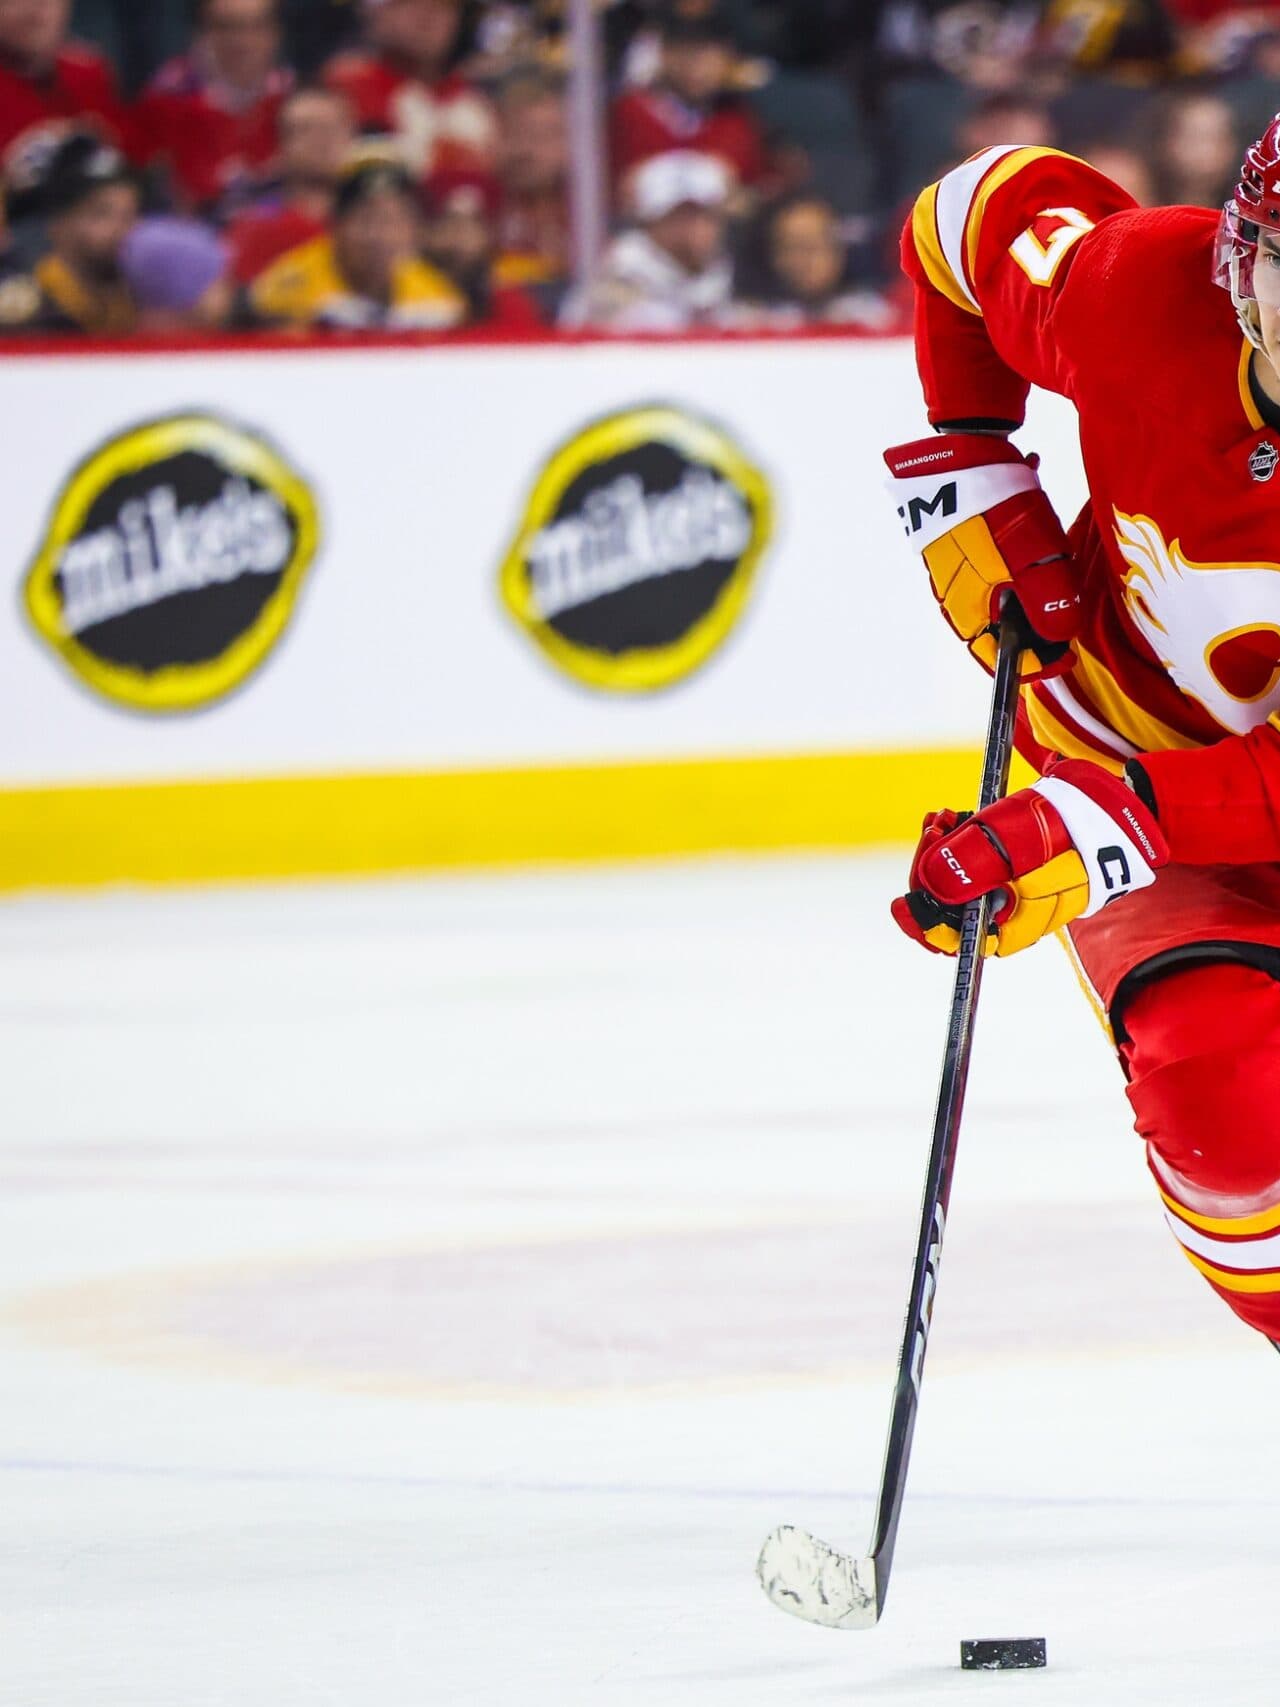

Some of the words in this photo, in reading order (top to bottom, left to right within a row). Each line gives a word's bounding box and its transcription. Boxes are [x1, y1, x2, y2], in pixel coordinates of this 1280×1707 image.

[894, 450, 954, 471] SHARANGOVICH
[1122, 807, 1157, 860] SHARANGOVICH
[940, 847, 972, 885] CCM
